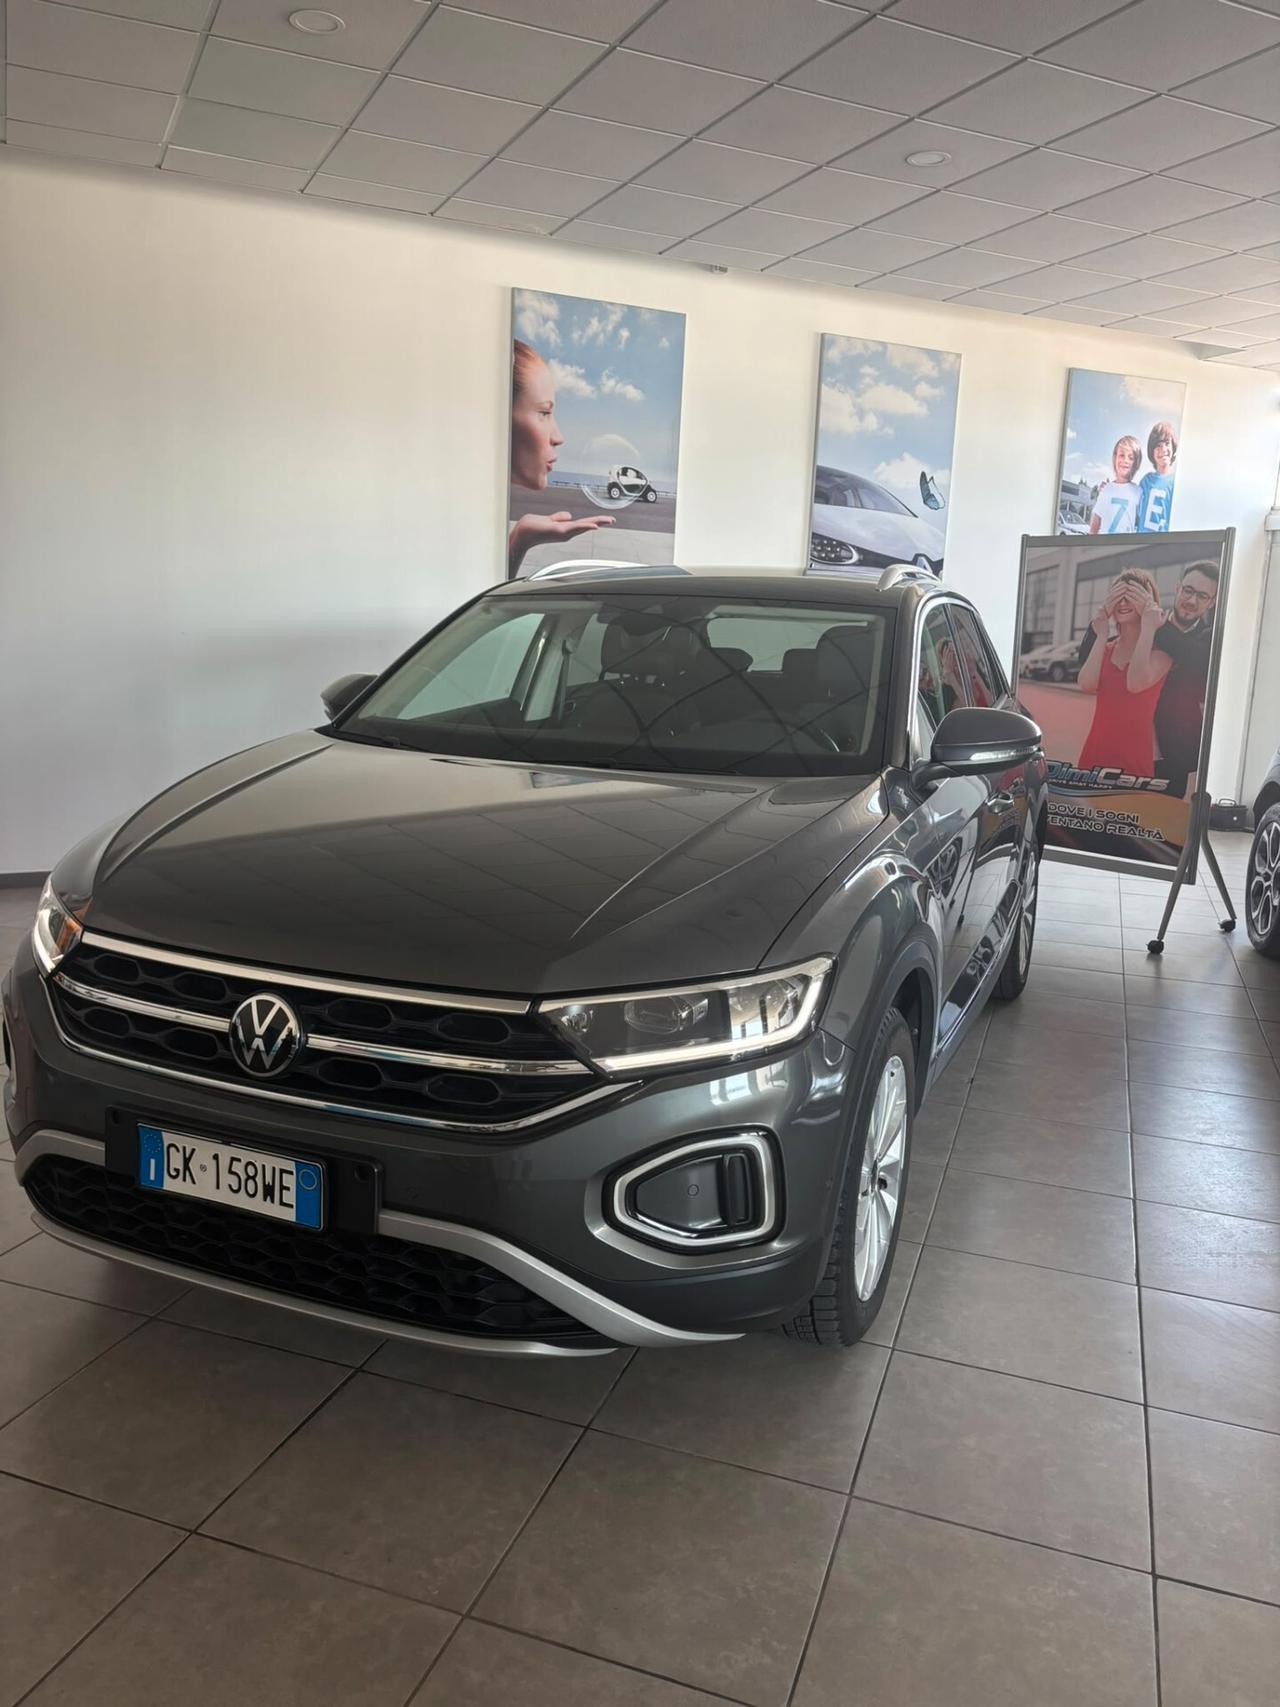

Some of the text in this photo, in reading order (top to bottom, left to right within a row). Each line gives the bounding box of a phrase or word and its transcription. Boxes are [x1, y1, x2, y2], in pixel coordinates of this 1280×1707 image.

[1108, 497, 1129, 533] 7
[1048, 803, 1140, 825] DOVE I SOGNI
[1106, 823, 1165, 841] REALTÀ
[166, 1142, 295, 1209] GK 158WE
